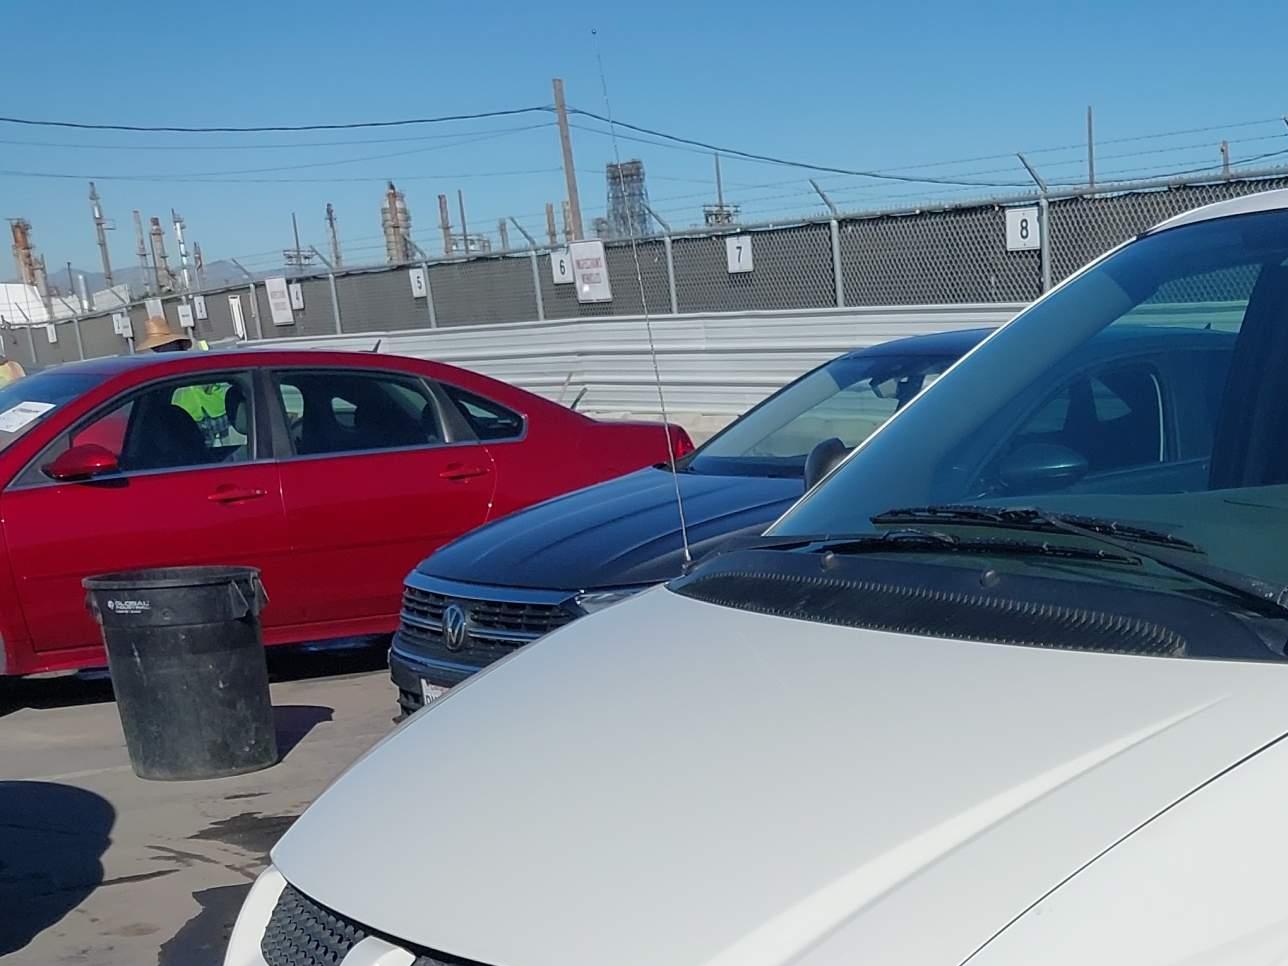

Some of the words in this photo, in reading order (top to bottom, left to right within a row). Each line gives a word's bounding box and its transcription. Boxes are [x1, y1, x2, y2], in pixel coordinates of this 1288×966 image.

[1020, 218, 1029, 240] 8
[735, 245, 743, 263] 7
[559, 259, 566, 275] 6
[416, 275, 423, 290] 5
